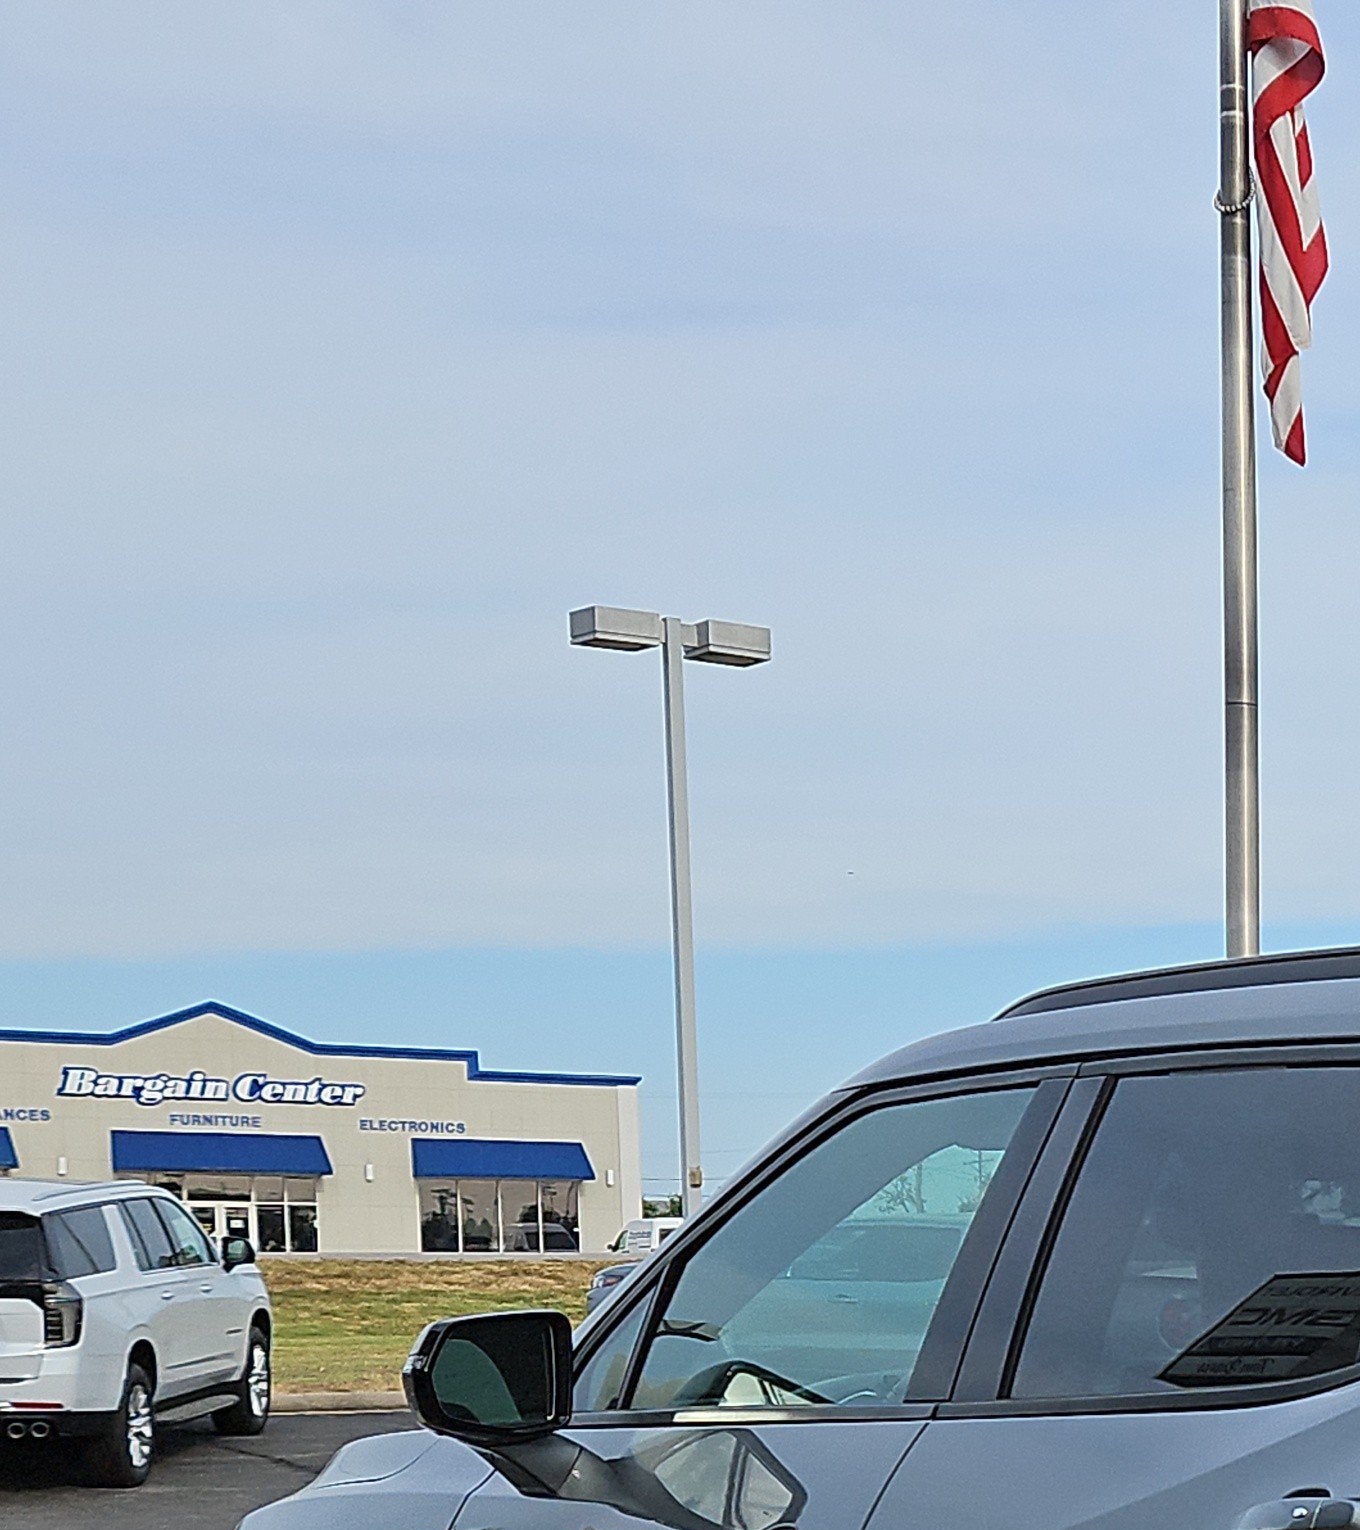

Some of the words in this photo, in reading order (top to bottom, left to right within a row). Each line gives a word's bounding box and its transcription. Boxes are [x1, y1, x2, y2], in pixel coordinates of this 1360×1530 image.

[57, 1066, 229, 1106] Bargain
[232, 1073, 365, 1105] Center
[169, 1114, 262, 1127] FURNITURE
[359, 1119, 465, 1133] ELECTRONICS
